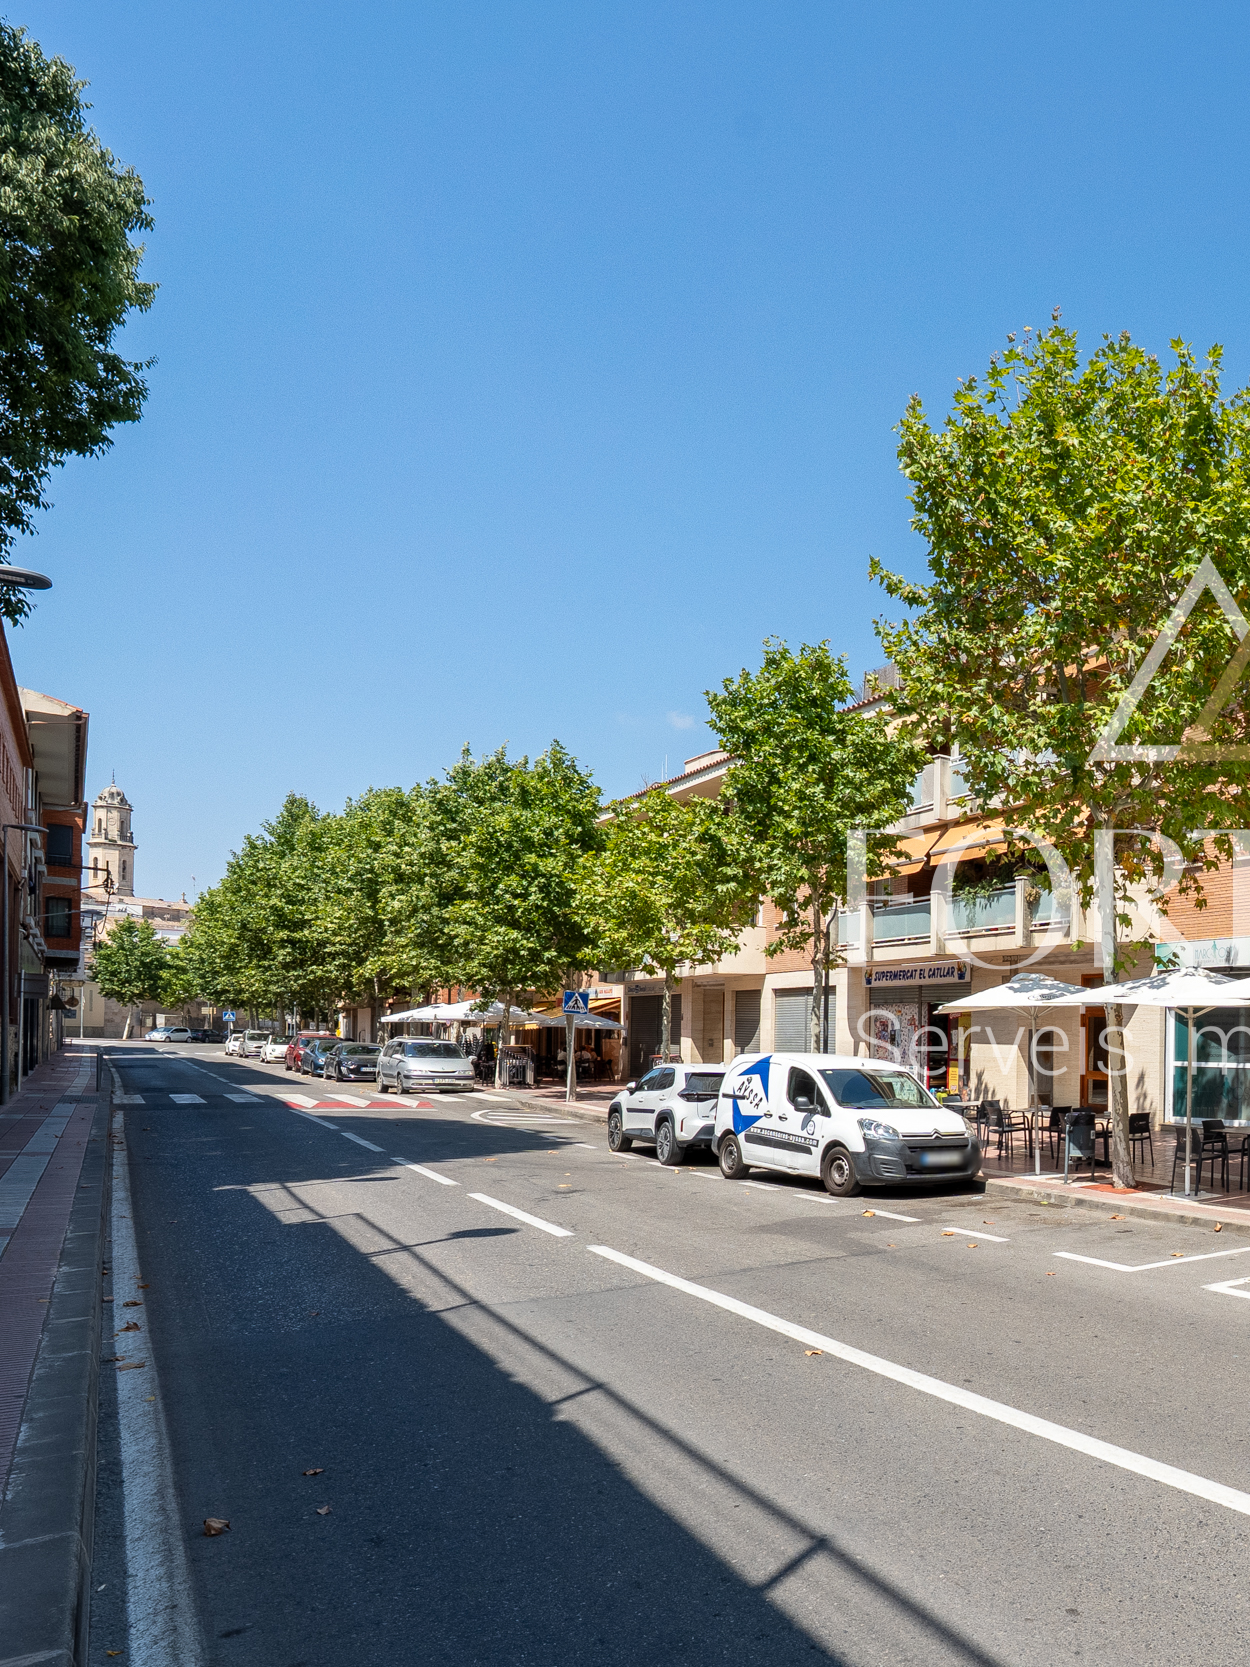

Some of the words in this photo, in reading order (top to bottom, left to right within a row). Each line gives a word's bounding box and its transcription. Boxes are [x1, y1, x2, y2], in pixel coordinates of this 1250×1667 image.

[874, 969, 917, 982] SUPERMERCAT
[919, 970, 927, 980] EL
[928, 966, 955, 979] CATLLAR
[737, 1081, 763, 1110] AYSSA
